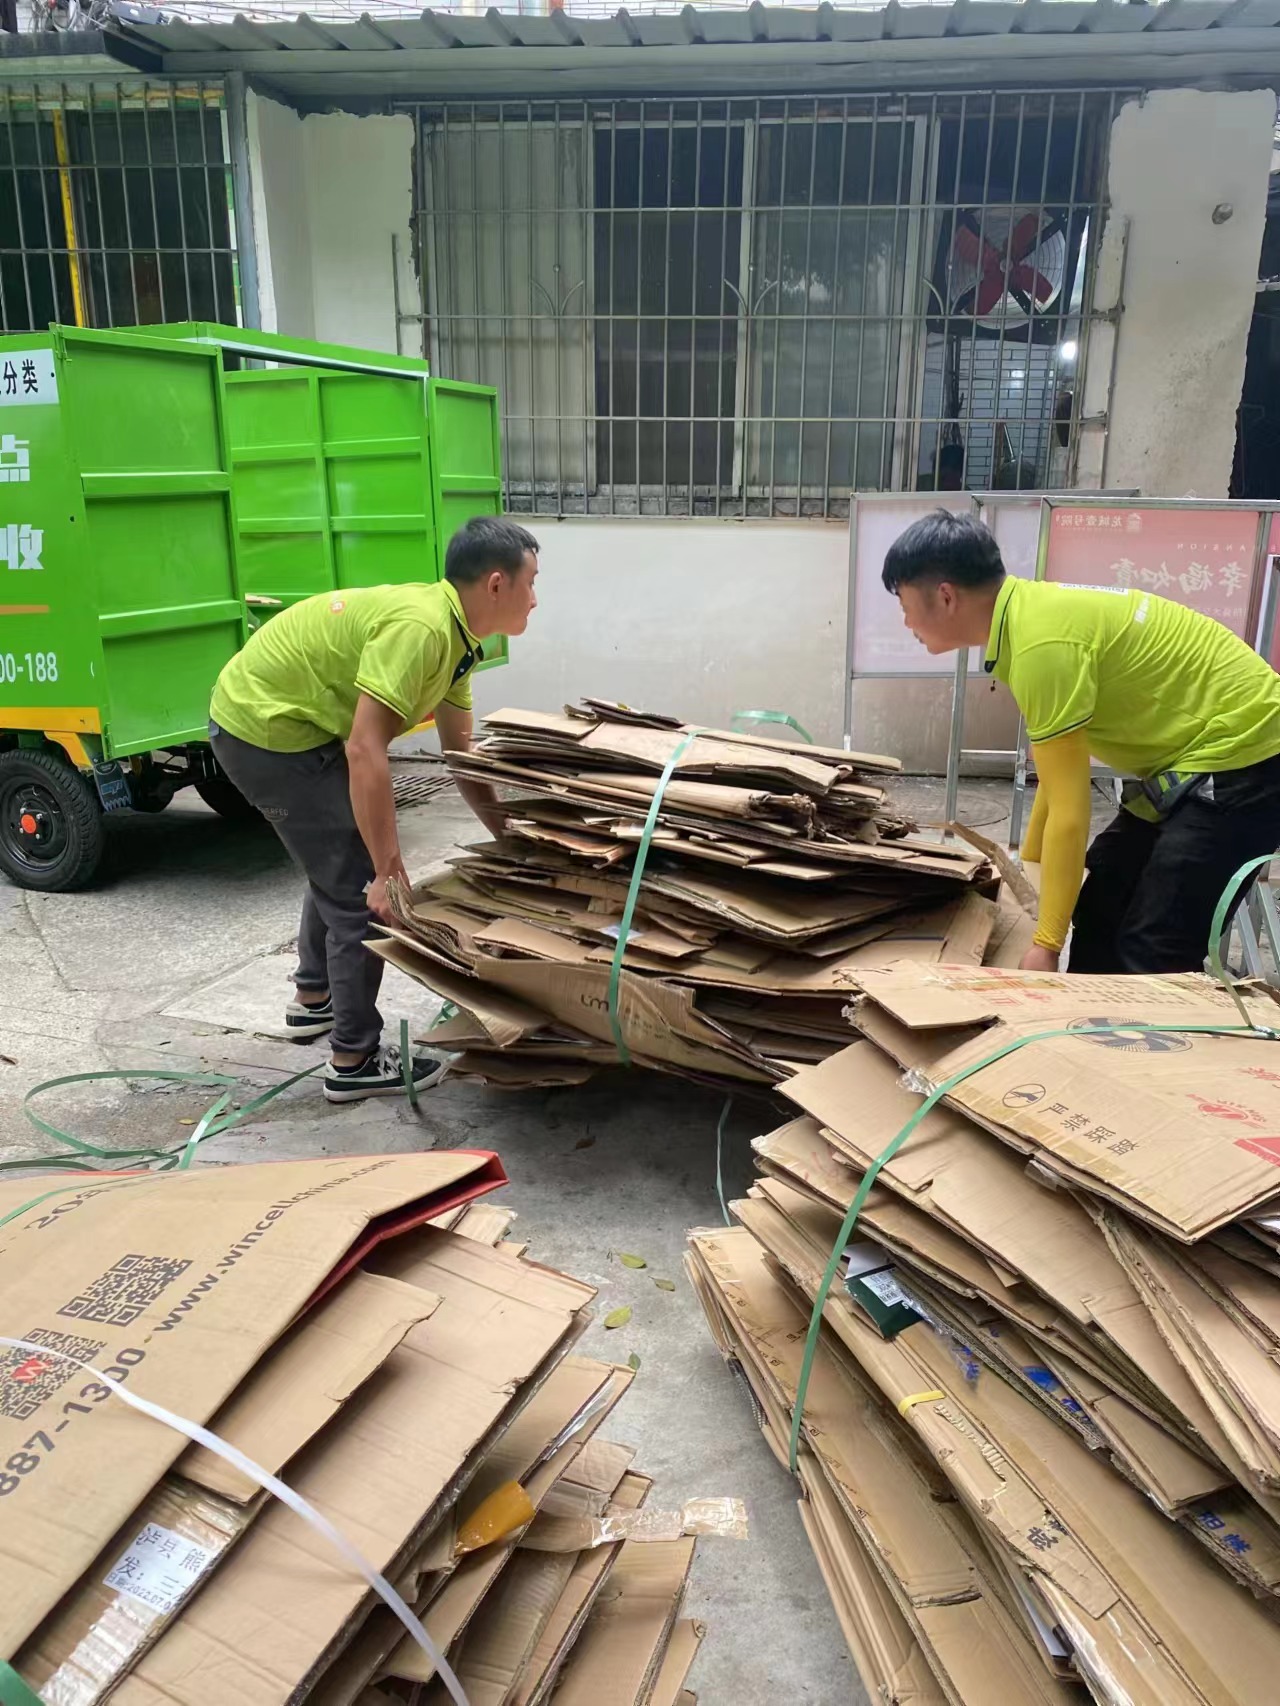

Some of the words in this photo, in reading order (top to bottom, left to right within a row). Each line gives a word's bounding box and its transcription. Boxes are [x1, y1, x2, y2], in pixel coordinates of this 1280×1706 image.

[0, 359, 38, 395] 分类
[0, 434, 30, 482] 点
[0, 524, 44, 570] 收
[1037, 1102, 1141, 1156] 严禁踩踏
[152, 1159, 396, 1332] www.wincellchina.com
